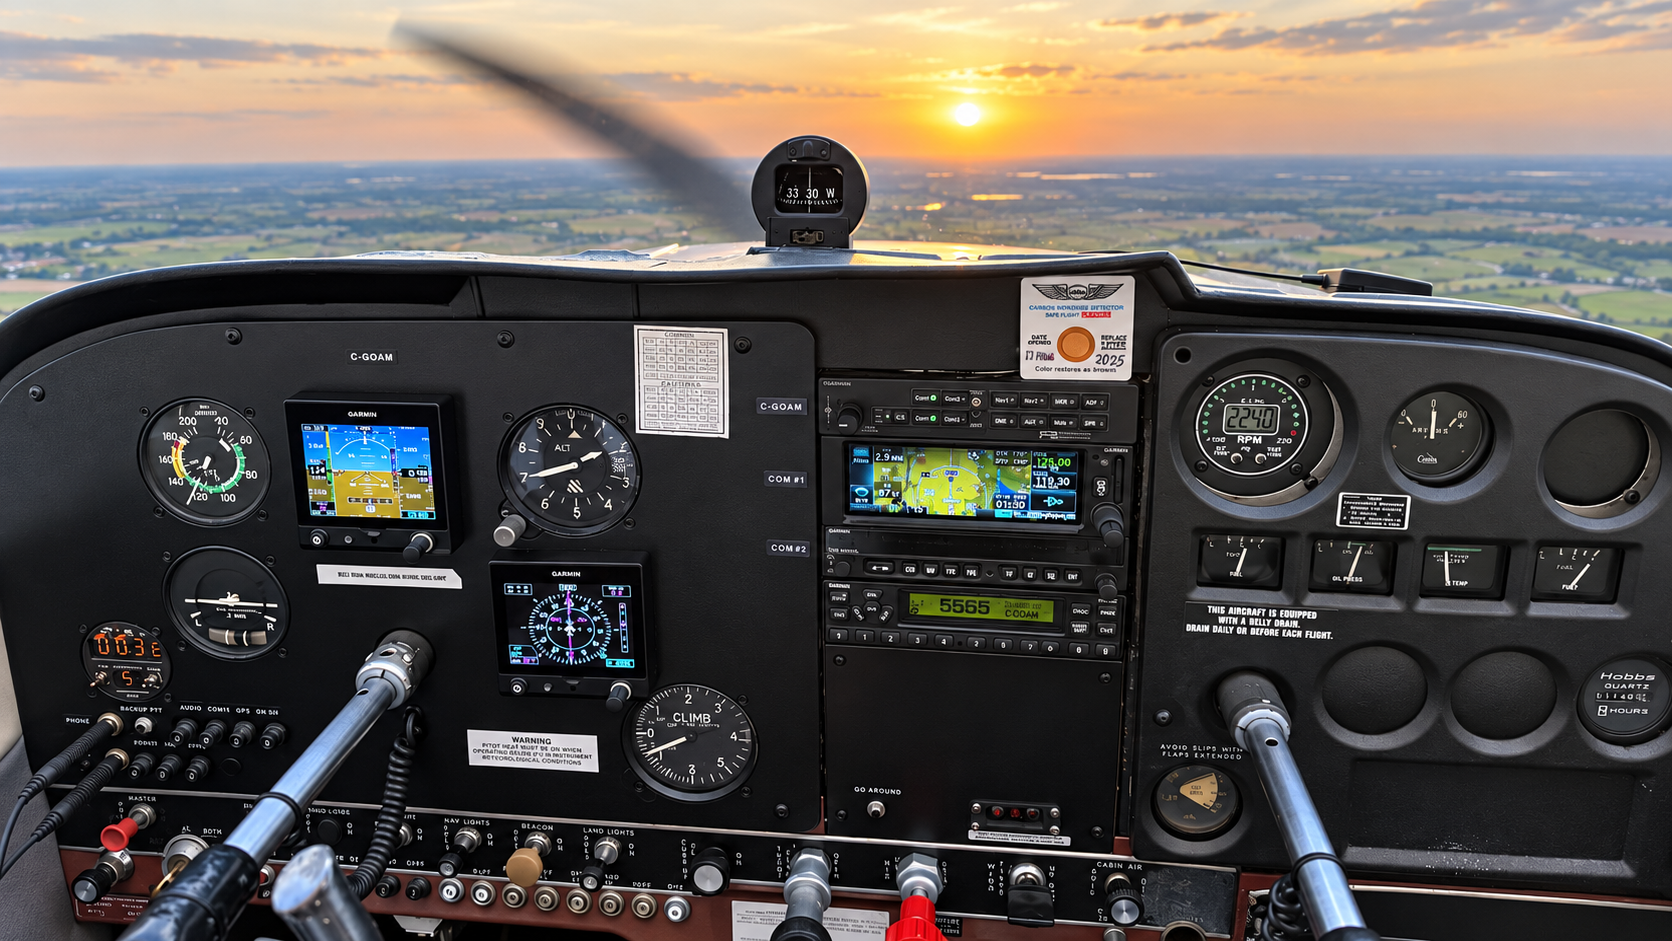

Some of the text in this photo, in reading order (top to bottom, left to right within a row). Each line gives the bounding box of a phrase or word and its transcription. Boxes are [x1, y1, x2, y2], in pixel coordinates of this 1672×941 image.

[786, 187, 835, 199] 33 30 W
[350, 353, 393, 361] C-GOAM
[1095, 354, 1126, 368] 2025
[760, 402, 802, 411] C-GOAM
[179, 416, 197, 426] 200
[1227, 407, 1275, 429] 2240
[536, 418, 545, 430] 9
[240, 436, 252, 445] 60
[1237, 435, 1262, 444] RPM
[554, 444, 571, 452] ALT
[158, 455, 173, 464] 160
[875, 453, 889, 462] 2.9
[245, 470, 258, 479] 80
[520, 472, 529, 483] 7
[768, 475, 804, 484] COM #1
[168, 477, 184, 486] 140
[193, 493, 236, 503] 120 100
[541, 498, 549, 510] 6
[604, 498, 613, 511] 4
[573, 507, 581, 520] 5
[771, 544, 806, 553] COM #2
[940, 598, 990, 615] 5565
[1228, 606, 1266, 617] AIRCRAFT
[1269, 609, 1277, 617] IS
[195, 619, 275, 631] L R
[1240, 617, 1246, 625] A
[1186, 624, 1210, 633] DRAIN
[1212, 625, 1234, 634] DAILY
[1236, 626, 1247, 635] OR
[1305, 630, 1333, 640] FLIGHT.
[1600, 672, 1656, 681] Hobbs
[684, 694, 692, 705] 2
[714, 703, 722, 714] 3
[65, 717, 90, 725] PHONE
[673, 712, 711, 724] CLIMB
[647, 728, 738, 742] 0 4
[512, 736, 552, 745] WARNING
[717, 757, 725, 768] 5
[868, 787, 901, 795] AROUND
[521, 823, 553, 831] BEACON
[1096, 861, 1142, 871] CABIN AIR
